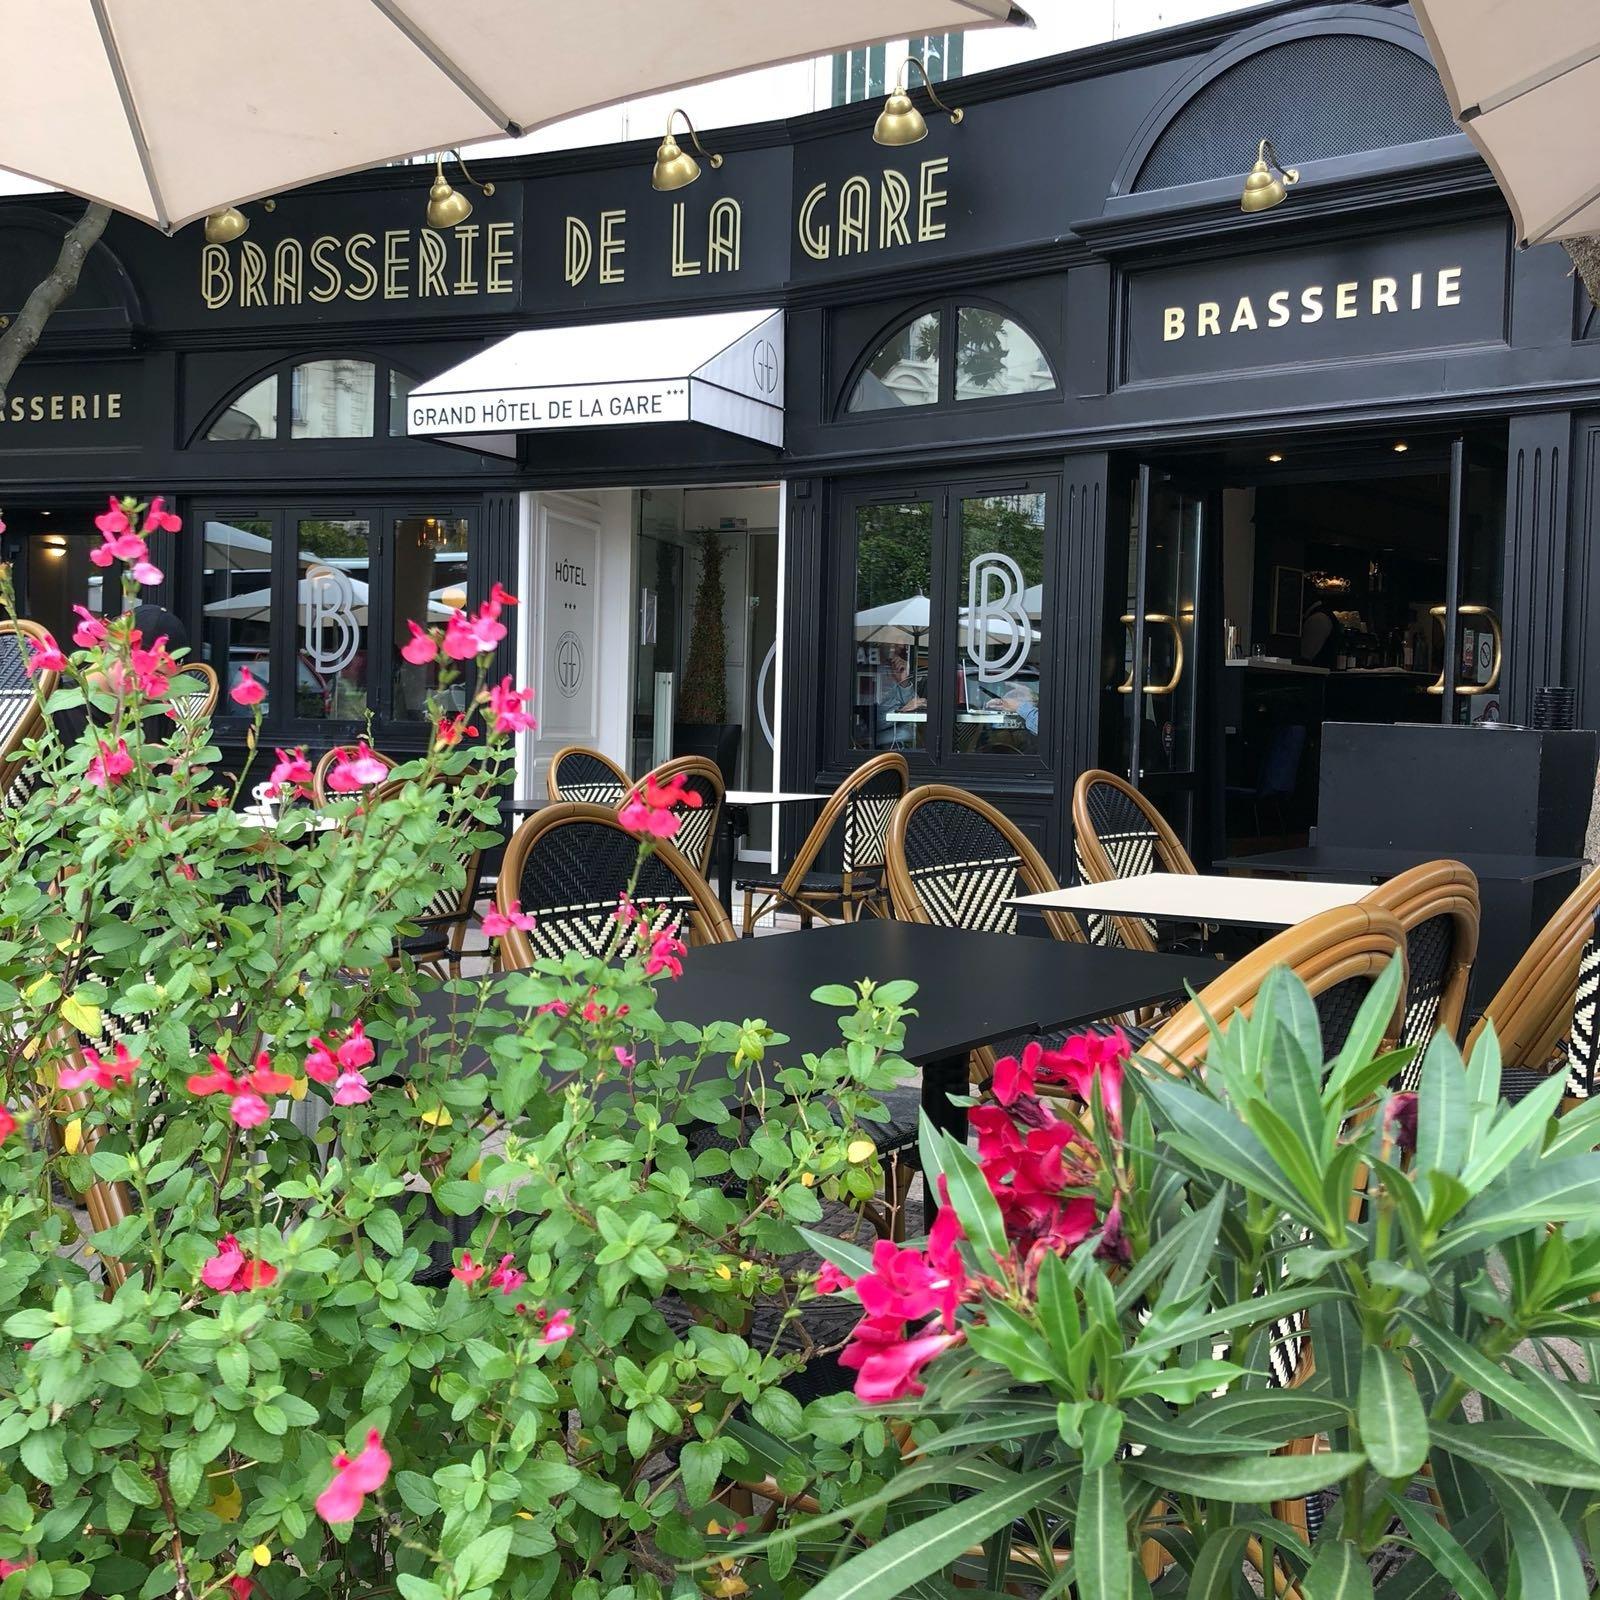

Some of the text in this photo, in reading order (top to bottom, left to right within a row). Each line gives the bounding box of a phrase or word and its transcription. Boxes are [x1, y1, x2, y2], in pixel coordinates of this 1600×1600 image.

[201, 156, 950, 310] BRASSERIE DE LA GARE
[1162, 266, 1463, 342] BRASSERIE
[413, 394, 663, 427] GRAND HÔTEL DE LA GARE
[554, 557, 587, 587] HÔTEL
[966, 552, 1032, 683] B
[305, 565, 360, 675] B
